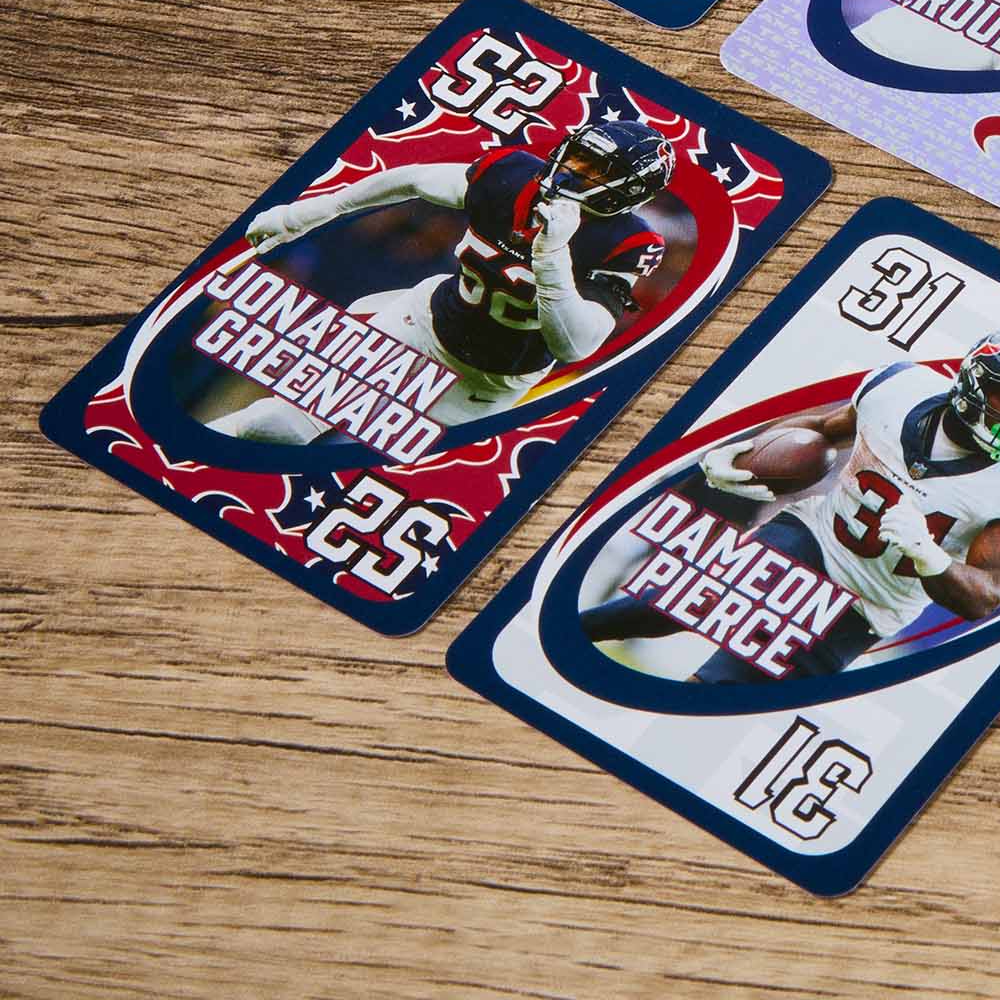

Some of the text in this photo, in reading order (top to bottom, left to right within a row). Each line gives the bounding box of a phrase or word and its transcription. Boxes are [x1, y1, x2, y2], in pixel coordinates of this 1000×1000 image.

[431, 31, 569, 136] 52
[210, 259, 461, 405] JONATHAN
[454, 226, 542, 330] 52
[837, 247, 966, 350] 31
[191, 311, 446, 467] GREENARD
[305, 473, 452, 598] 52
[635, 490, 861, 647] DAMEON
[621, 548, 813, 682] PIERCE
[733, 715, 875, 842] 31
